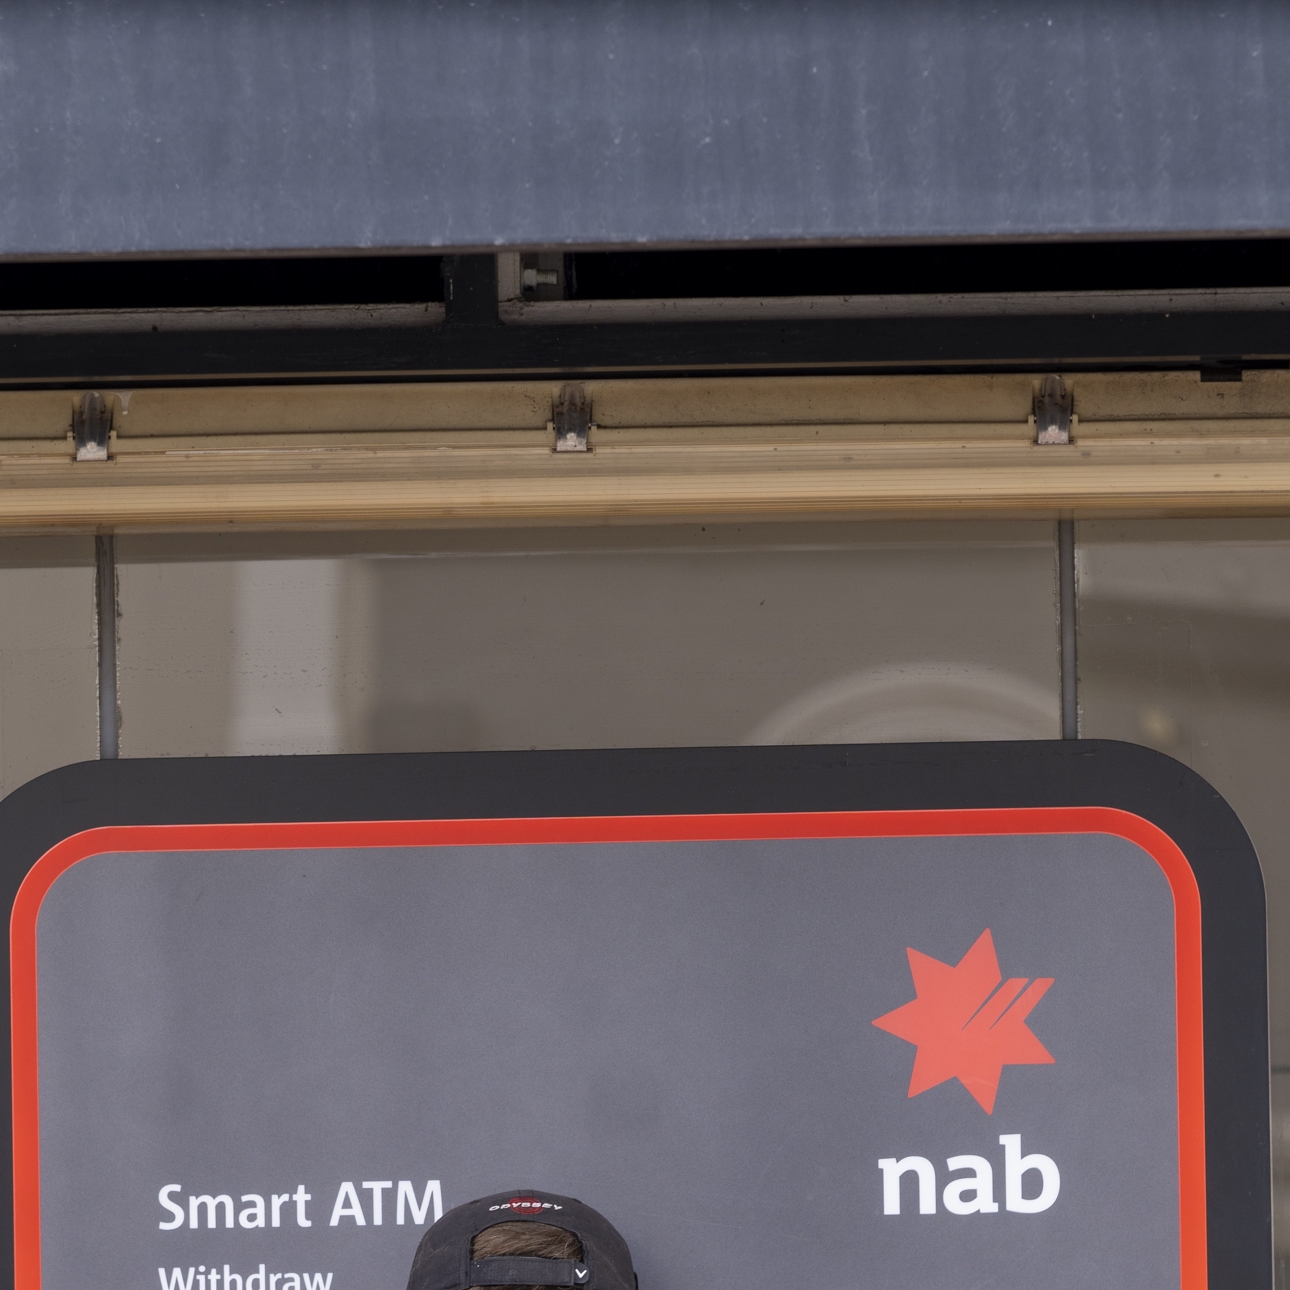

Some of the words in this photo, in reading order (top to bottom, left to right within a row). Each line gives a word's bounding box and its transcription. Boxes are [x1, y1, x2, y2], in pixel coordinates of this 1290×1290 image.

[878, 1133, 1061, 1216] nab
[158, 1184, 312, 1232] Smart
[329, 1180, 444, 1228] ATM
[488, 1202, 562, 1212] ODYSSEY
